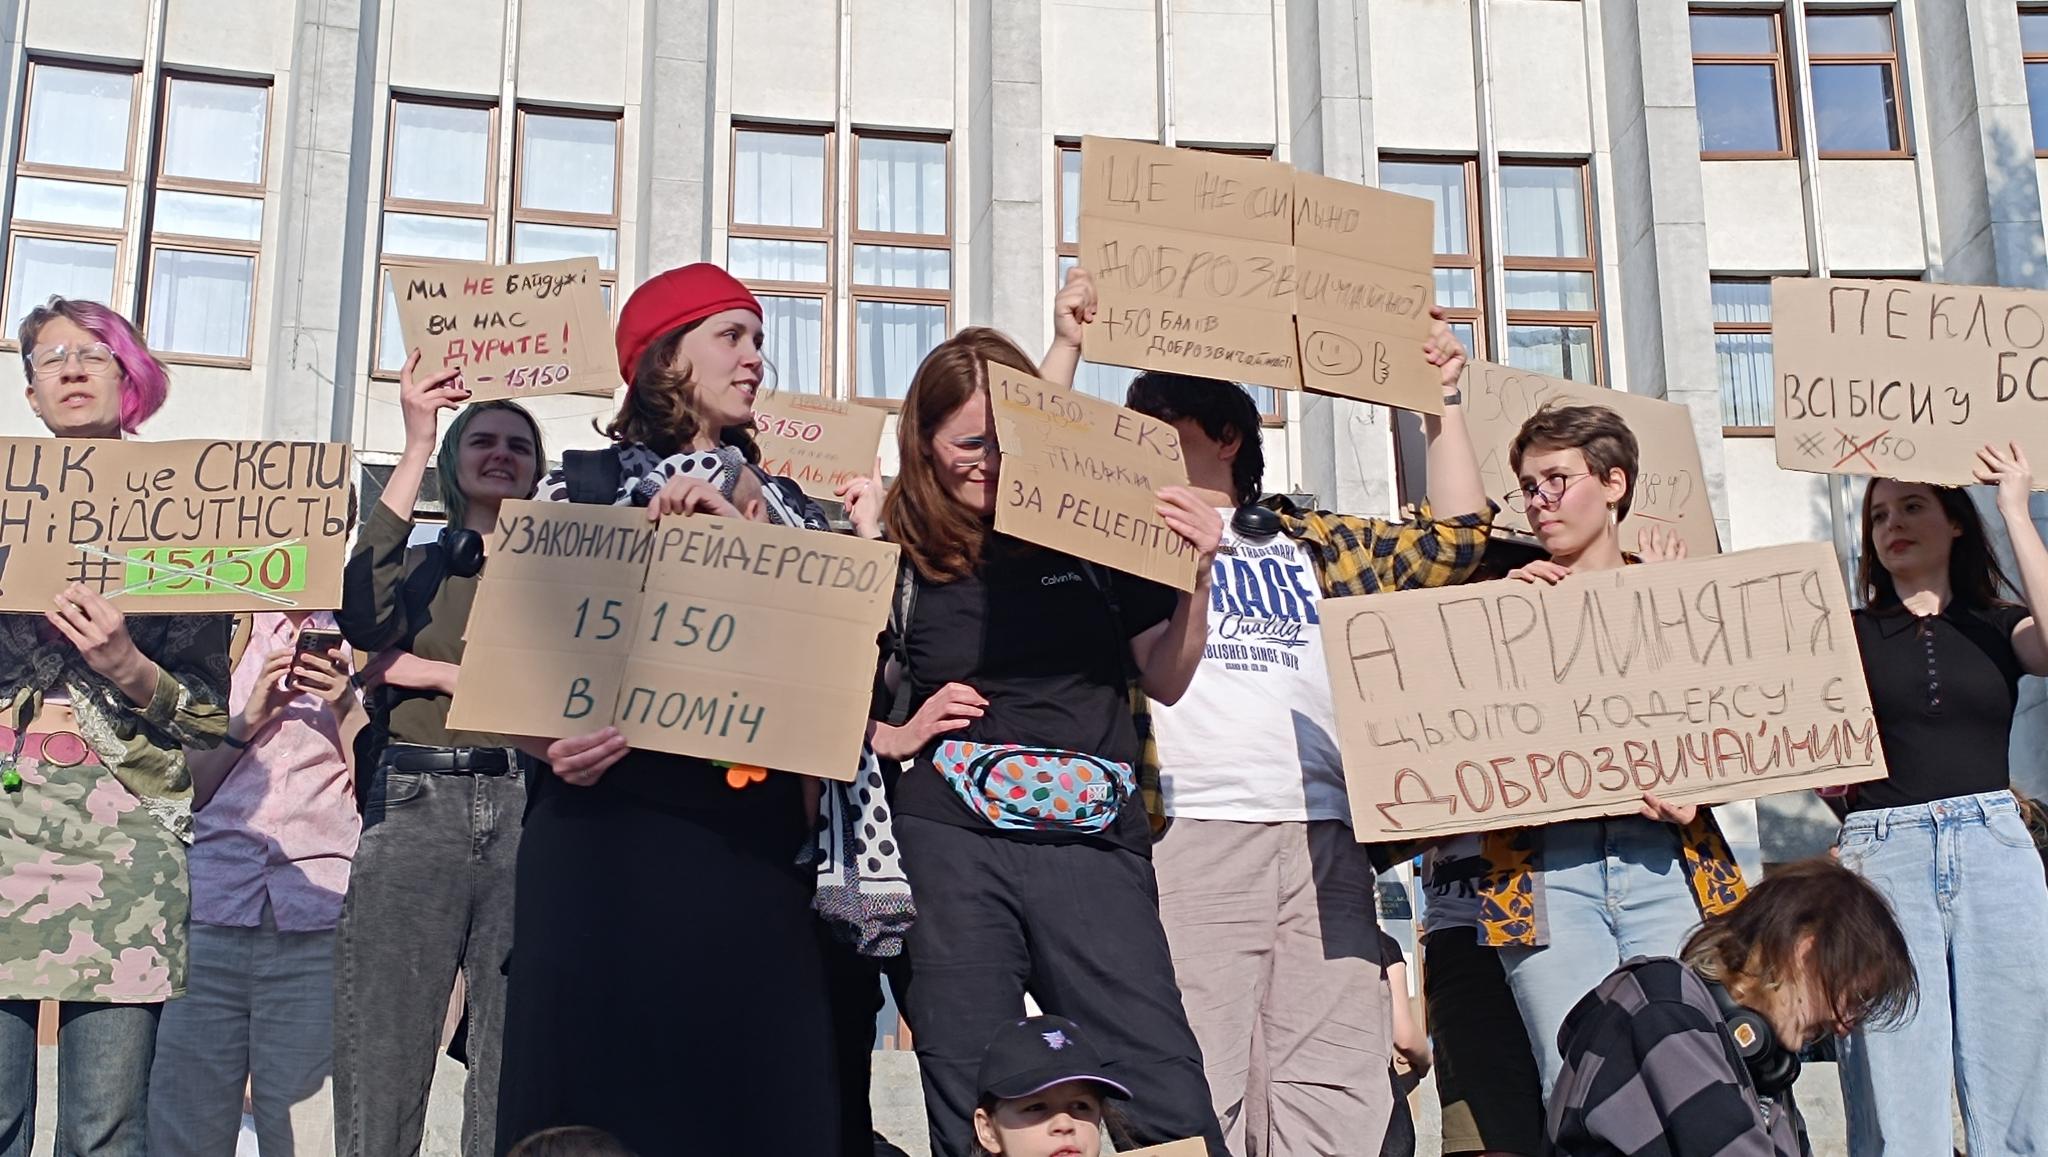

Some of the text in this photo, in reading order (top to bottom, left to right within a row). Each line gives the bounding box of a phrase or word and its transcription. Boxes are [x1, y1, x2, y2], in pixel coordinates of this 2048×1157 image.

[463, 277, 495, 296] НЕ
[473, 311, 528, 331] НАС
[1102, 297, 1150, 341] +50
[1829, 286, 2044, 349] ПЕКЛО
[504, 365, 570, 388] 15150
[752, 409, 822, 441] 5150
[126, 468, 176, 498] це
[498, 514, 655, 565] УЗАКОНИТИ
[1009, 480, 1195, 562] ЗА РЕЦЕПТОМ
[1240, 544, 1296, 562] TRADEMARK
[1219, 611, 1303, 648] Quality
[1346, 571, 1834, 702] А ПРИЙНЯТТЯ
[1250, 645, 1280, 664] SINCE
[562, 677, 595, 719] В
[1366, 702, 1543, 754] ЦЬОГО
